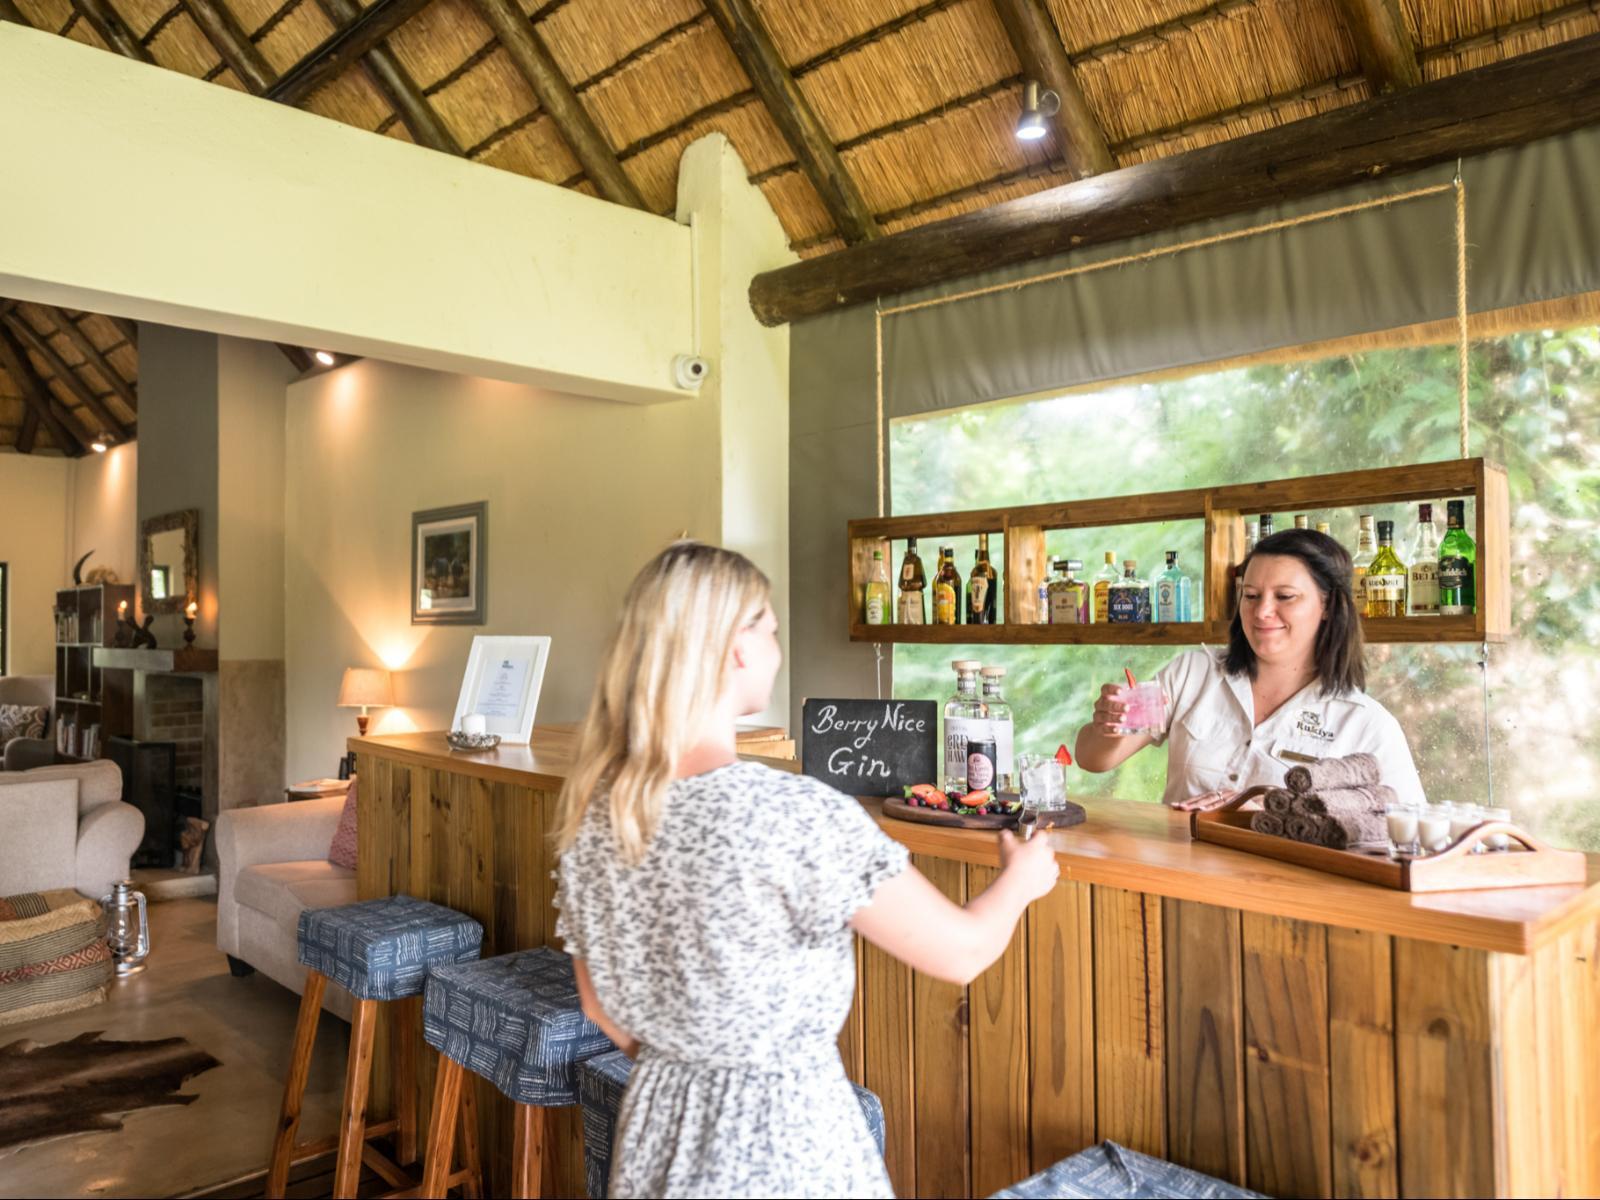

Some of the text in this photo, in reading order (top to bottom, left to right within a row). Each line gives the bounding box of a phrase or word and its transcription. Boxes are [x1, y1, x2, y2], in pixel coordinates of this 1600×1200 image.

[811, 703, 926, 749] Berry Nice
[828, 746, 891, 778] Gin
